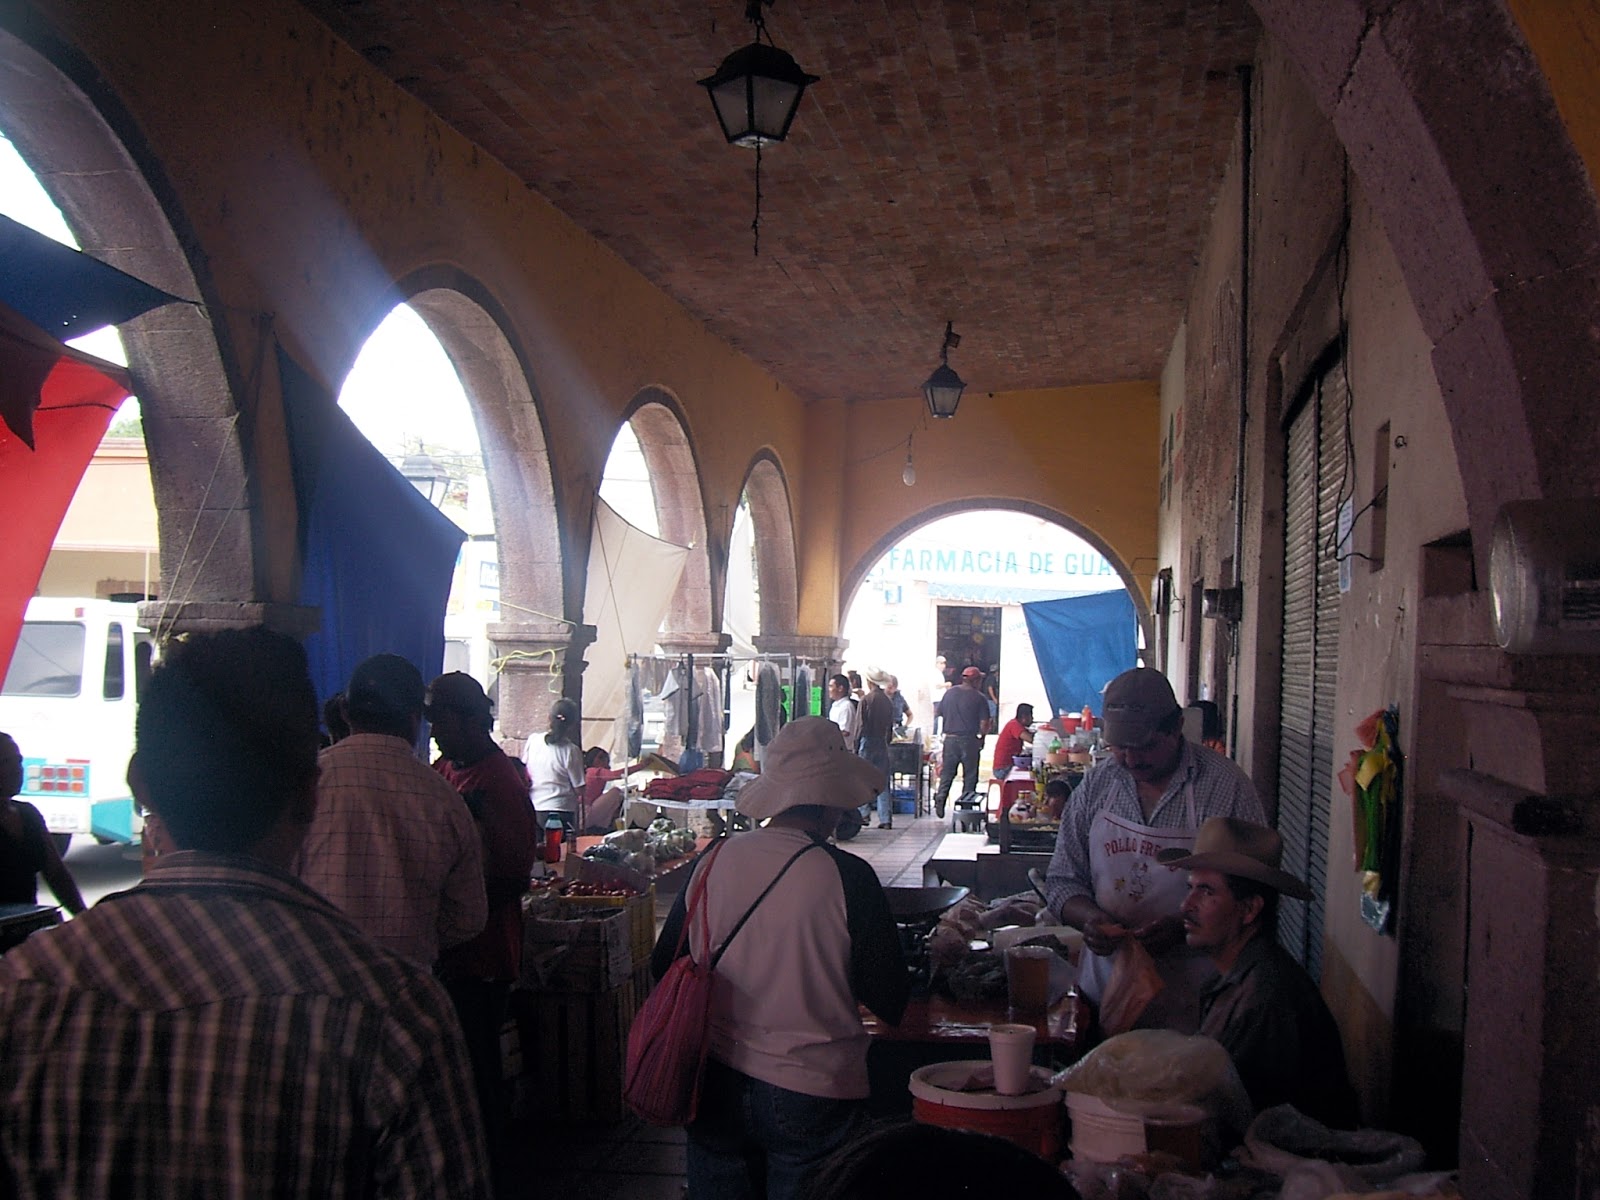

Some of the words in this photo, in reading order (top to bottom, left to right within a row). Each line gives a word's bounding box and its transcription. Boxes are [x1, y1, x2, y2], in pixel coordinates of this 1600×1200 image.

[889, 547, 1019, 573] FARMACIA
[1030, 551, 1054, 574] DE
[1105, 837, 1137, 856] POLLO
